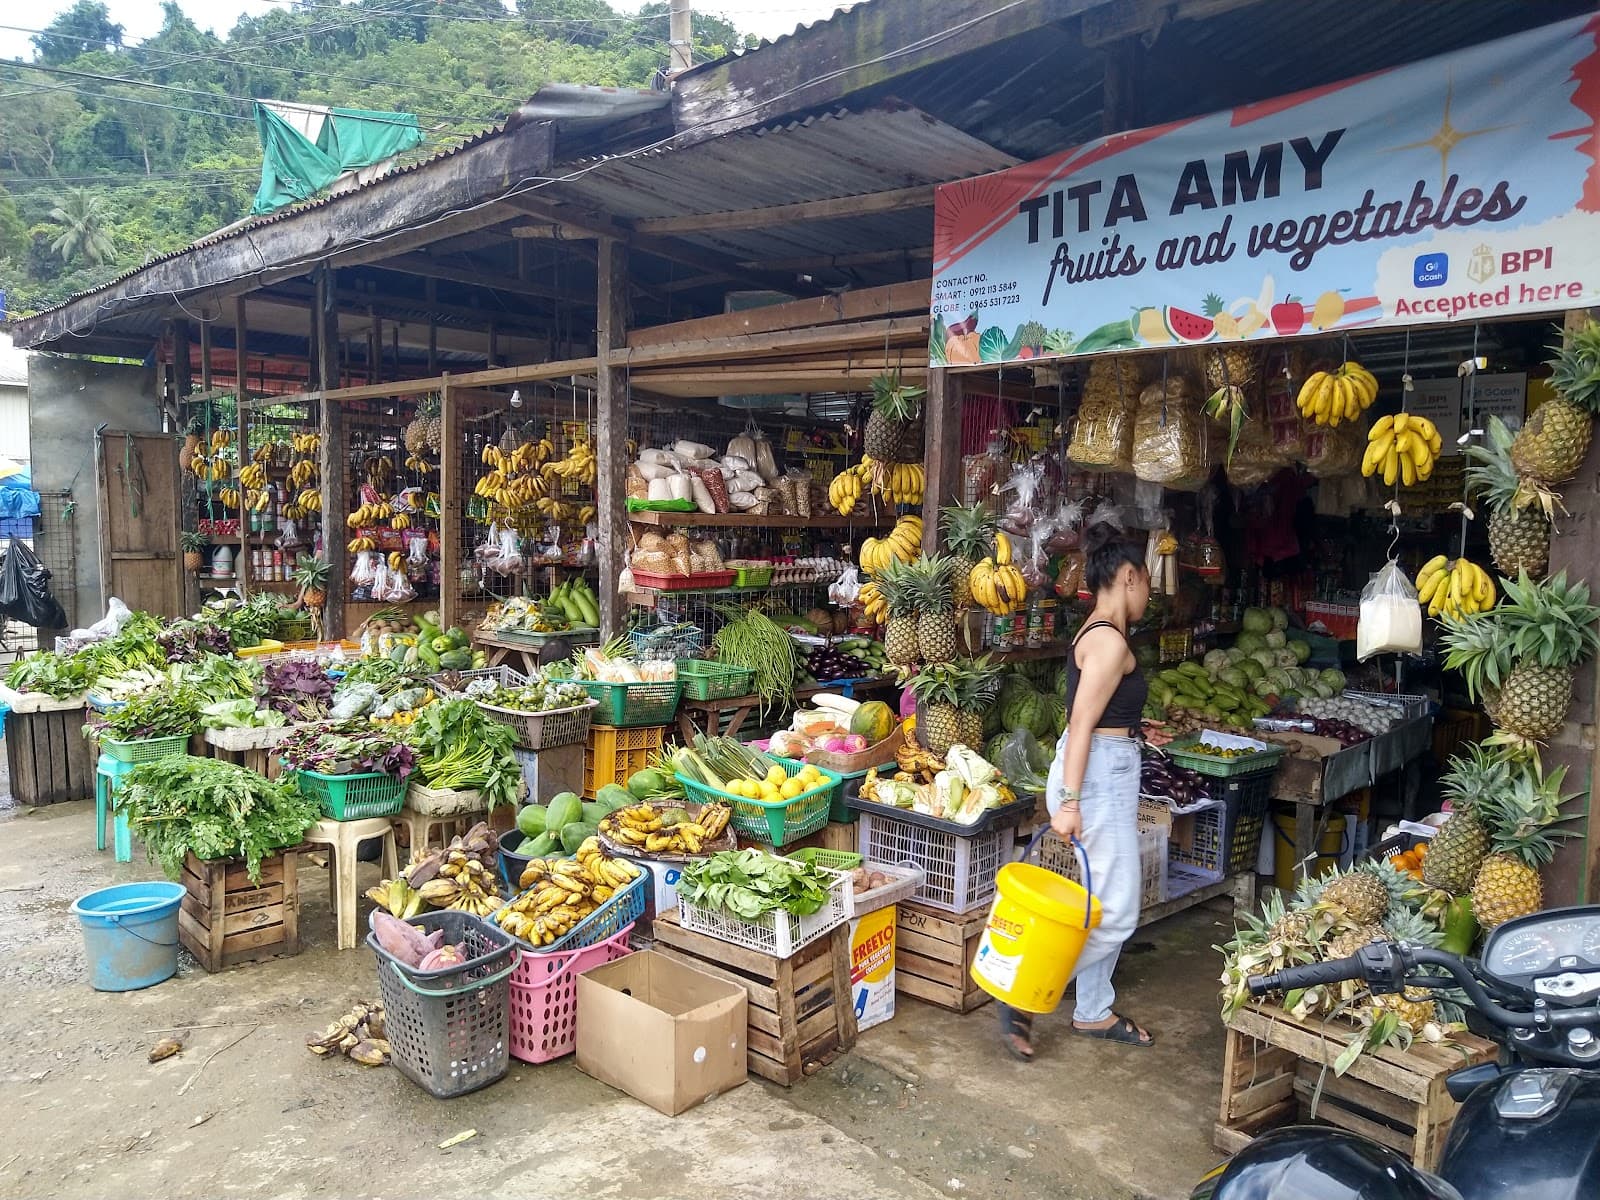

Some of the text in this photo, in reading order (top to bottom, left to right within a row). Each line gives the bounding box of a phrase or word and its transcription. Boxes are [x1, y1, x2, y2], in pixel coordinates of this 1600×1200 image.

[1019, 128, 1347, 245] TITA AMY
[1042, 174, 1527, 307] fruits and vegetables
[1501, 246, 1553, 275] BPI
[934, 290, 962, 301] SMART
[969, 286, 986, 297] 0912
[987, 284, 997, 295] 113
[998, 281, 1018, 293] 5849
[936, 273, 988, 289] CONTACT NO.
[1418, 272, 1443, 282] GCash
[933, 303, 960, 314] GLOBE
[969, 299, 988, 310] 0965
[989, 297, 1002, 307] 531
[1002, 294, 1020, 305] 7223
[1394, 281, 1583, 317] Accepted here
[853, 923, 894, 964] FREETO
